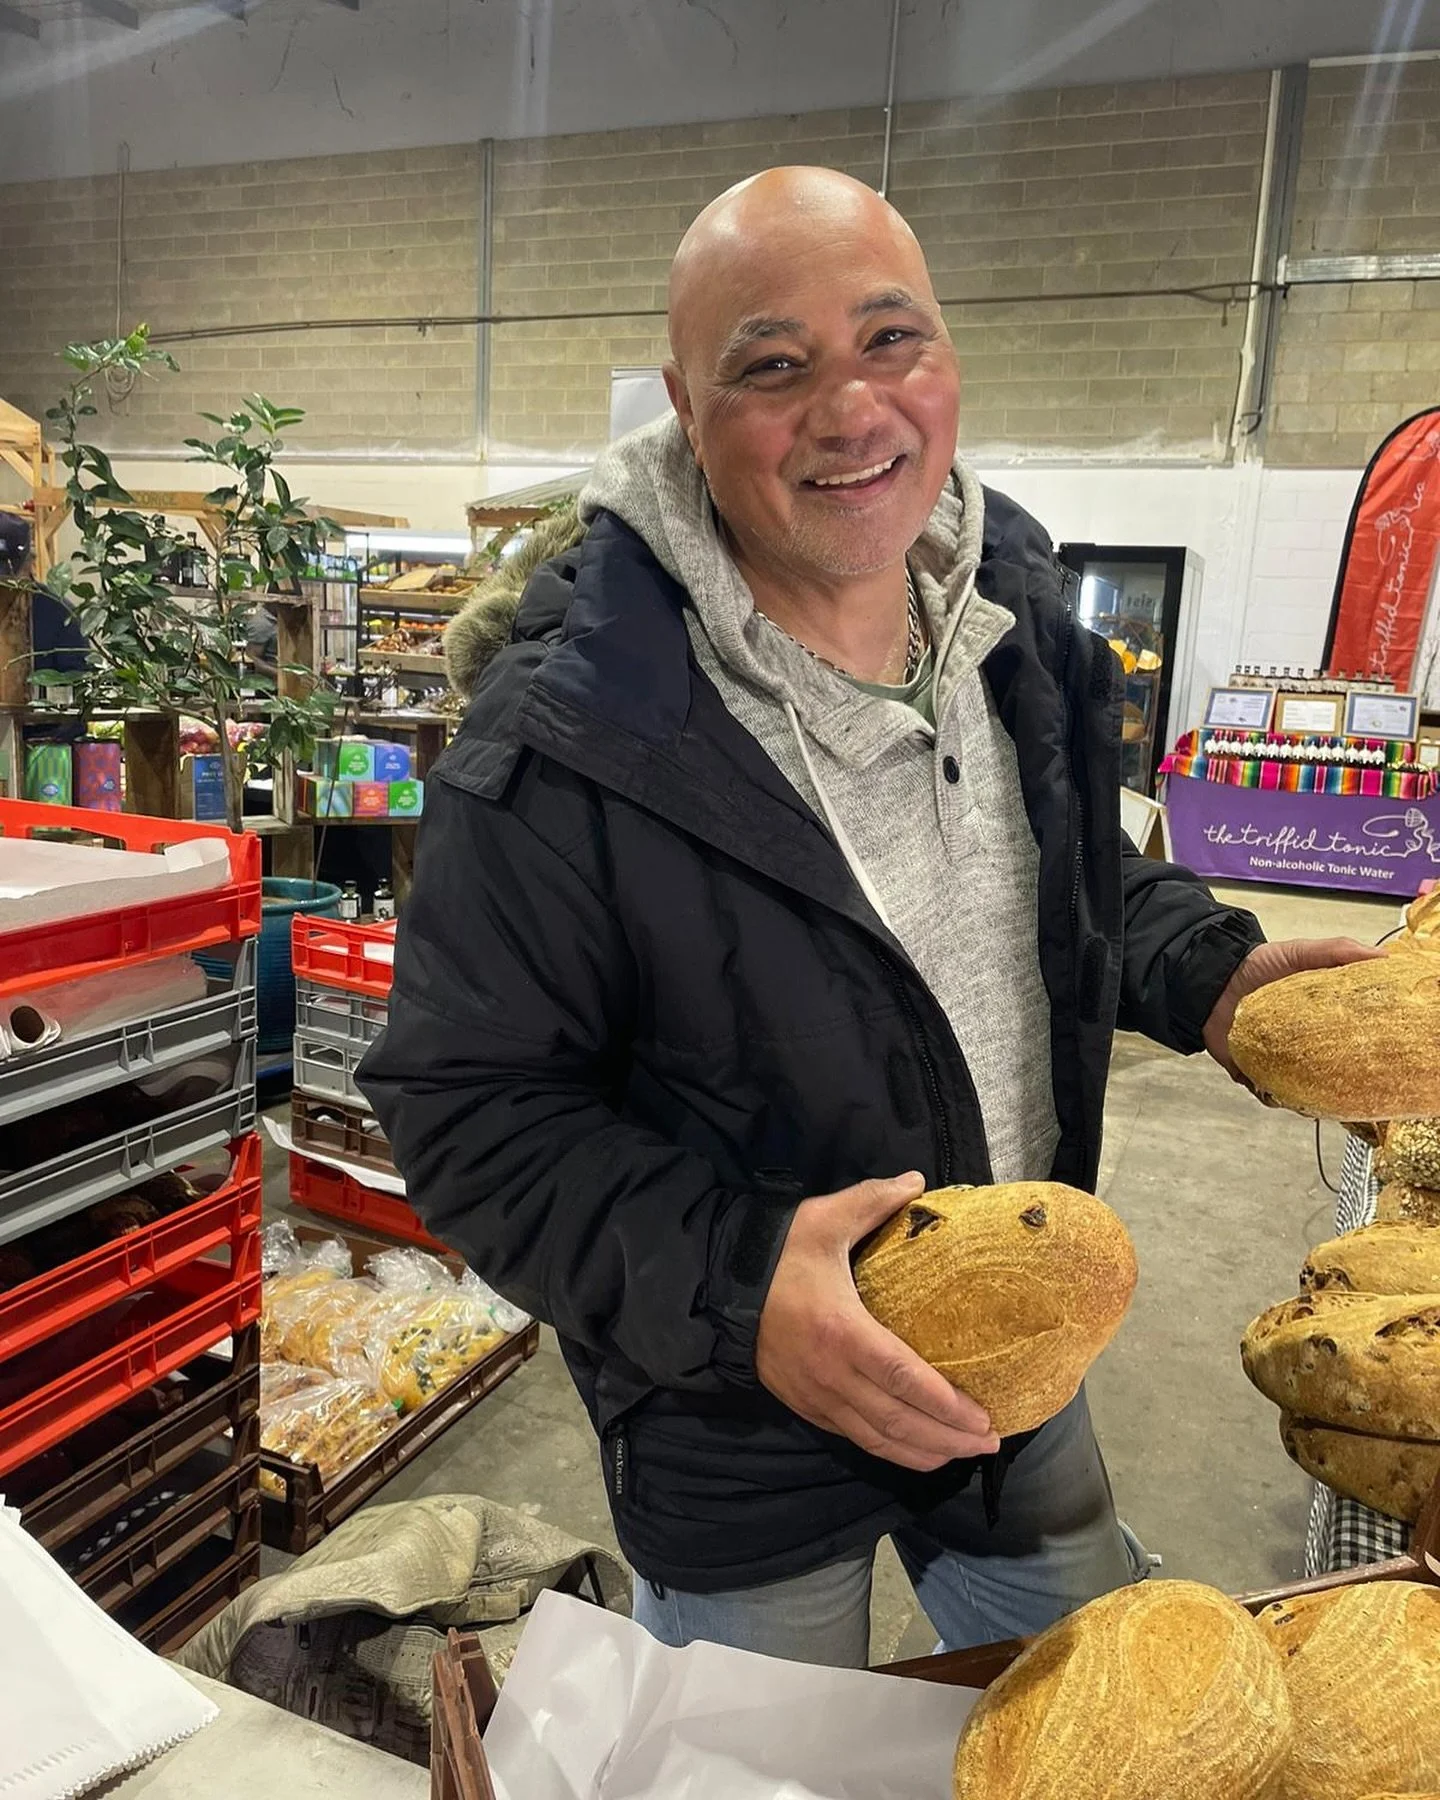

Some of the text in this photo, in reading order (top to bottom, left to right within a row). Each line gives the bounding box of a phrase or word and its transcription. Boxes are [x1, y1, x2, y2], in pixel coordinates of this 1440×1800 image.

[1203, 823, 1392, 857] the triffid tonic
[1249, 856, 1395, 880] Non-alcoholic Tonic Water
